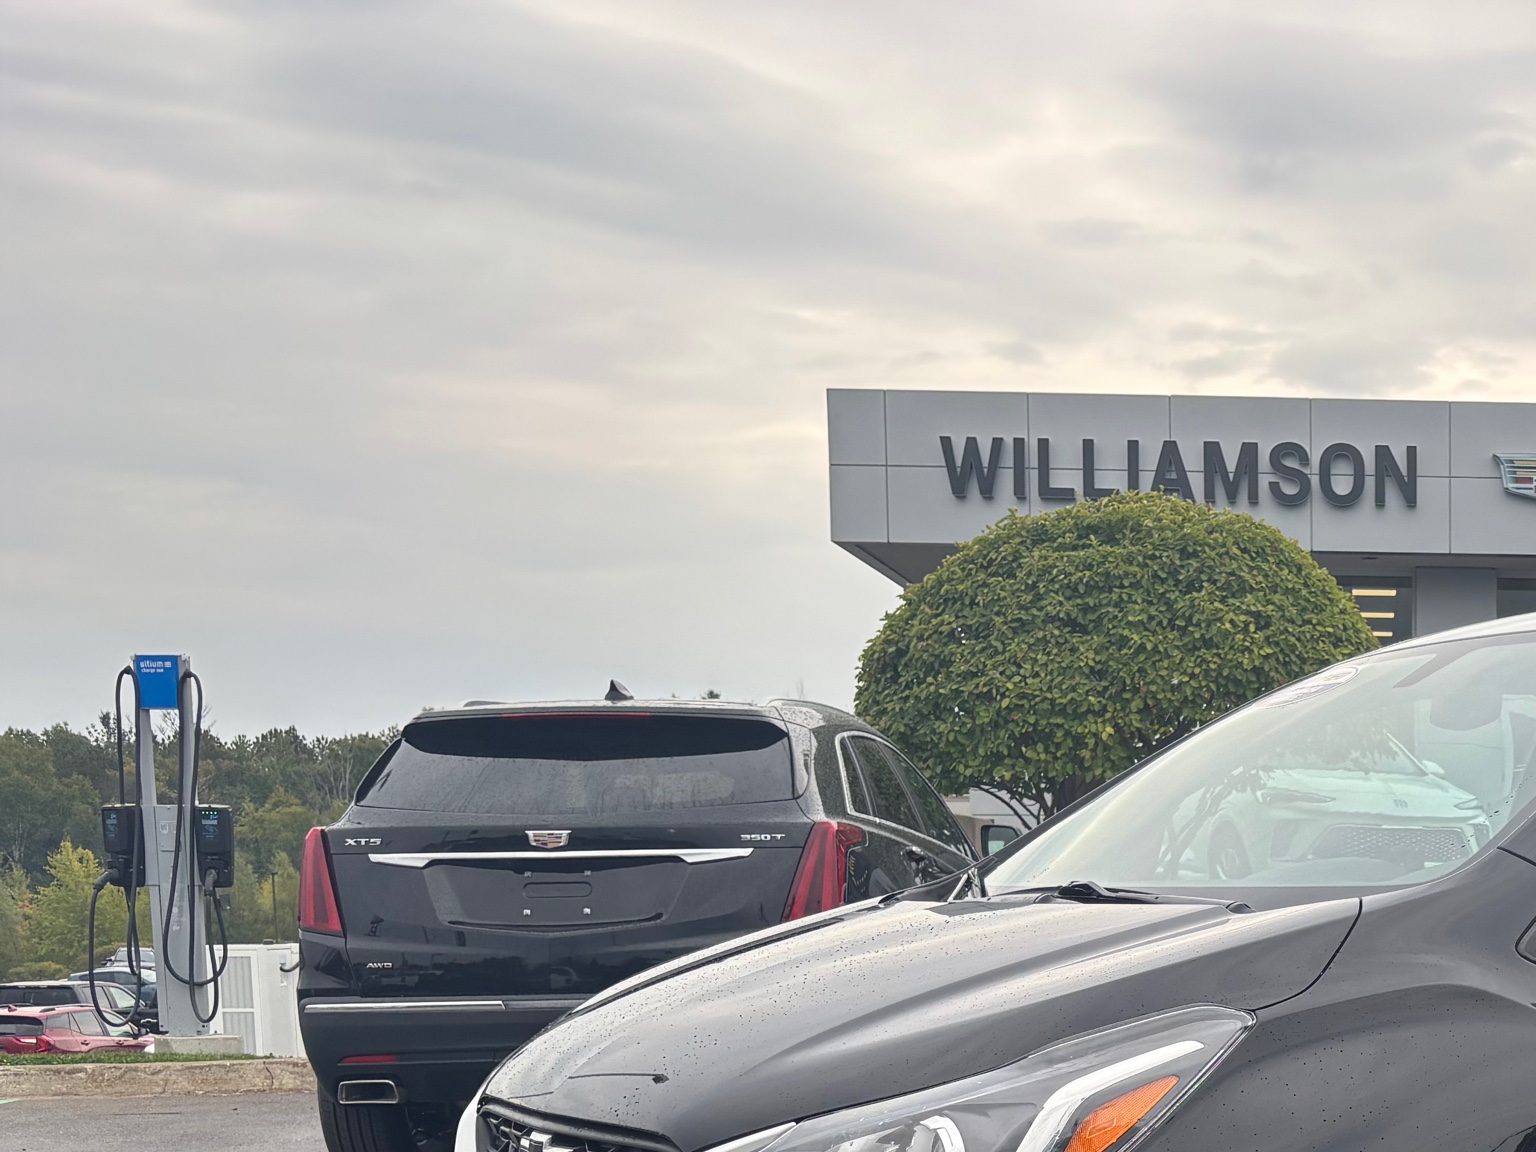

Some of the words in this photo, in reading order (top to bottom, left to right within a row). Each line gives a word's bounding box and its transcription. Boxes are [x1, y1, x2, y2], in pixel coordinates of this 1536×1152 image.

[939, 435, 1419, 507] WILLIAMSON
[740, 833, 786, 841] 350T
[344, 838, 382, 846] XT5
